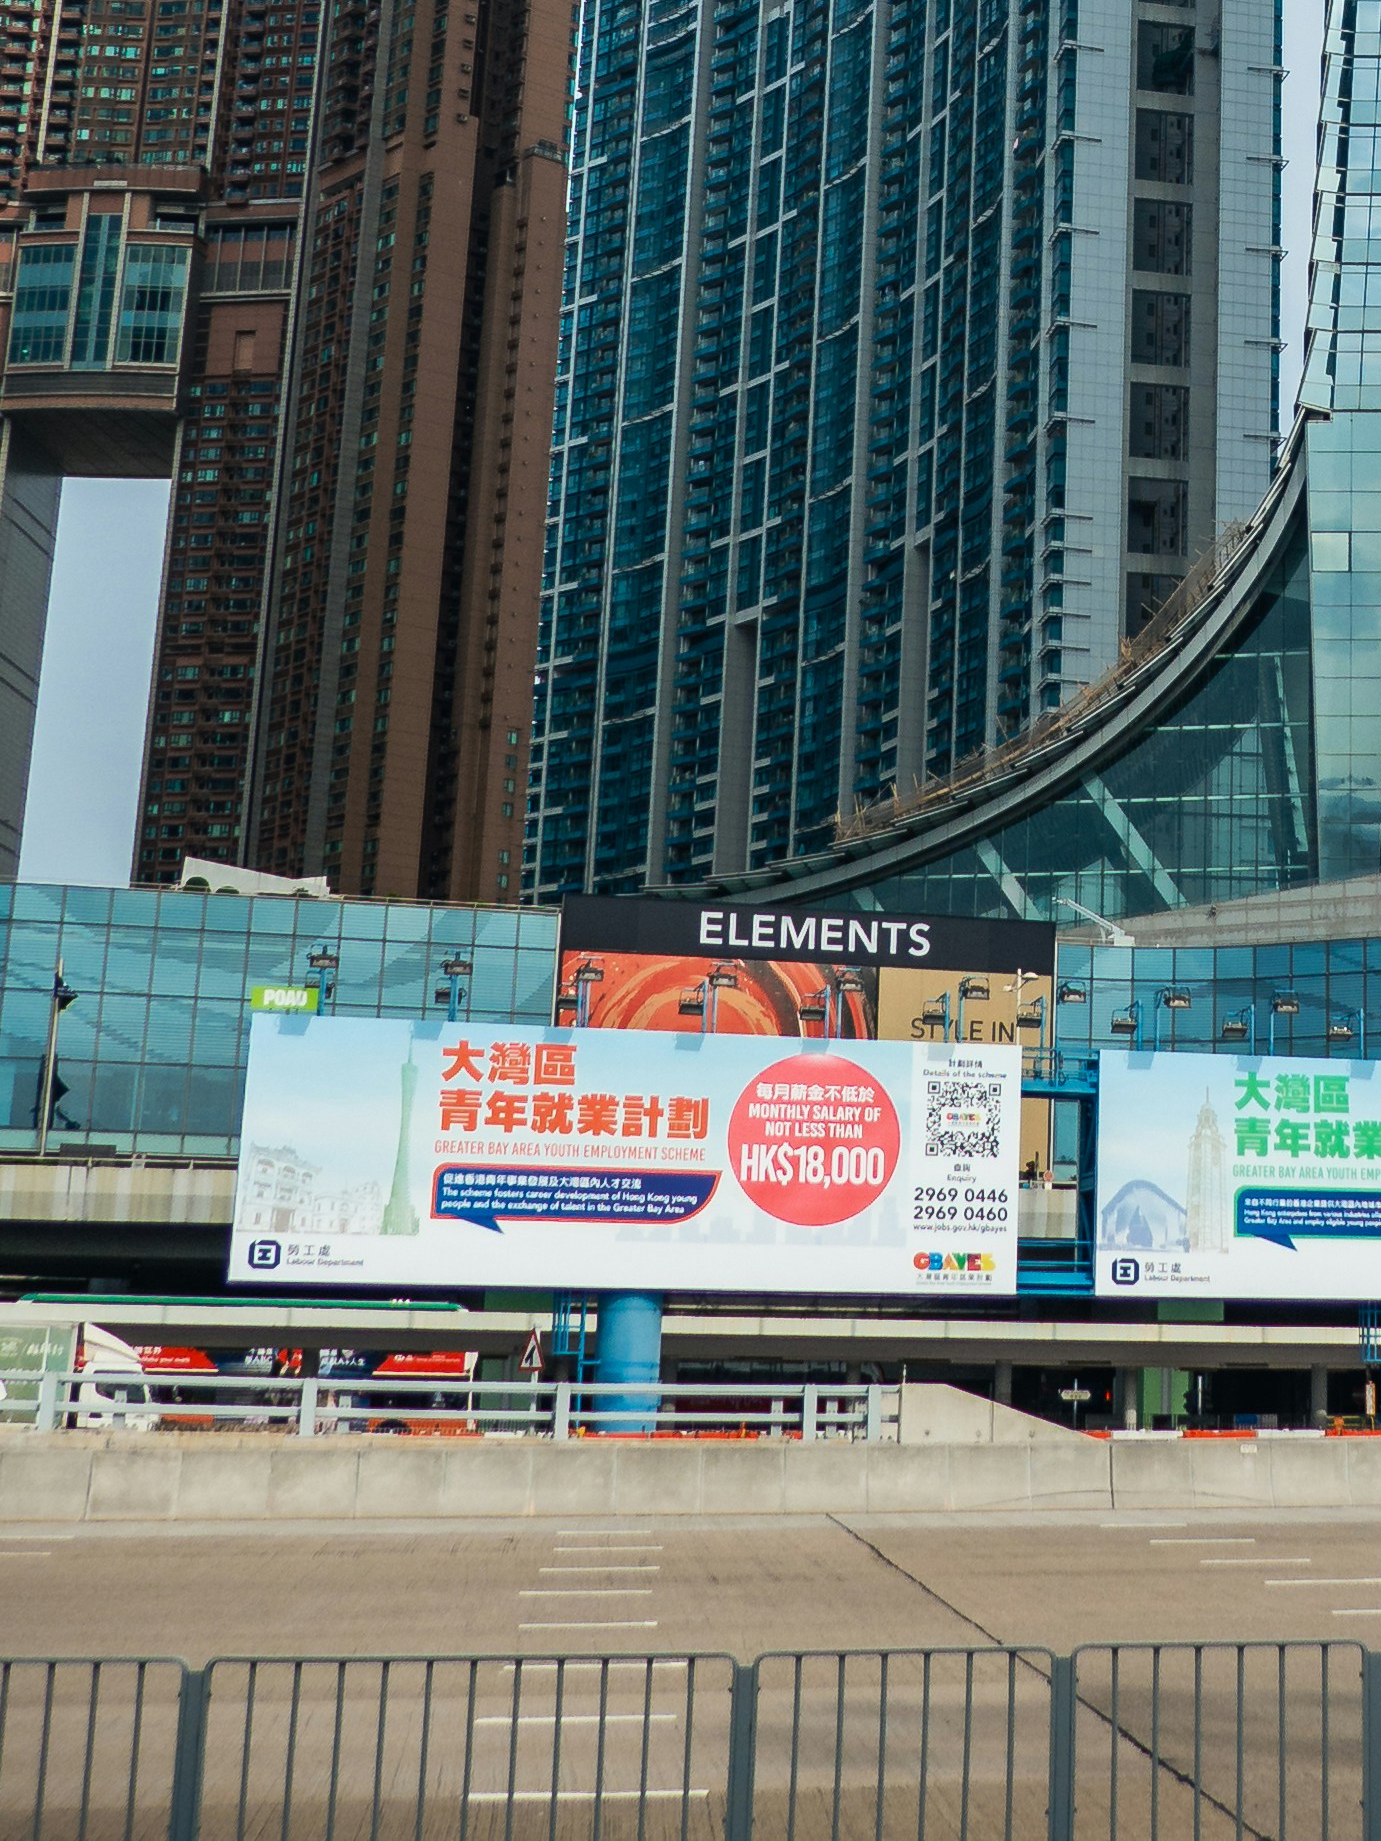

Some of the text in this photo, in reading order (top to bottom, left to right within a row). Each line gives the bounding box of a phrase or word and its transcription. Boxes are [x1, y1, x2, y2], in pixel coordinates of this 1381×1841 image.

[700, 910, 932, 957] ELEMENTS
[264, 988, 308, 1007] POAD
[992, 1020, 1015, 1043] IN
[441, 1039, 578, 1086] 大灣區
[923, 1069, 950, 1077] Details
[756, 1082, 875, 1104] 每月薪金不低於
[1234, 1071, 1350, 1114] 大灣區
[439, 1088, 710, 1140] 青年就業計劃
[748, 1103, 882, 1123] MONTHLY SALARY OF
[765, 1121, 863, 1139] NOT LESS THAN
[434, 1140, 707, 1162] GREATER BAY AREA YOUTH EMPLOYMENT SCHEME
[739, 1141, 886, 1190] HK$18,000
[1232, 1164, 1277, 1178] GREATER
[1278, 1165, 1296, 1179] BAY
[1299, 1166, 1324, 1180] AREA
[1327, 1167, 1357, 1181] YOUTH
[947, 1174, 977, 1183] Enquiry
[443, 1187, 698, 1205] The scheme fosters career development of Hong Kong young
[914, 1187, 1008, 1203] 2969 0446
[441, 1199, 685, 1215] people and the exchange of talent in the Greater Bay Area
[913, 1205, 1008, 1221] 2969 0460
[913, 1223, 1008, 1234] www.jobs.gov.hk/gbayes
[287, 1244, 331, 1256] 勞工處
